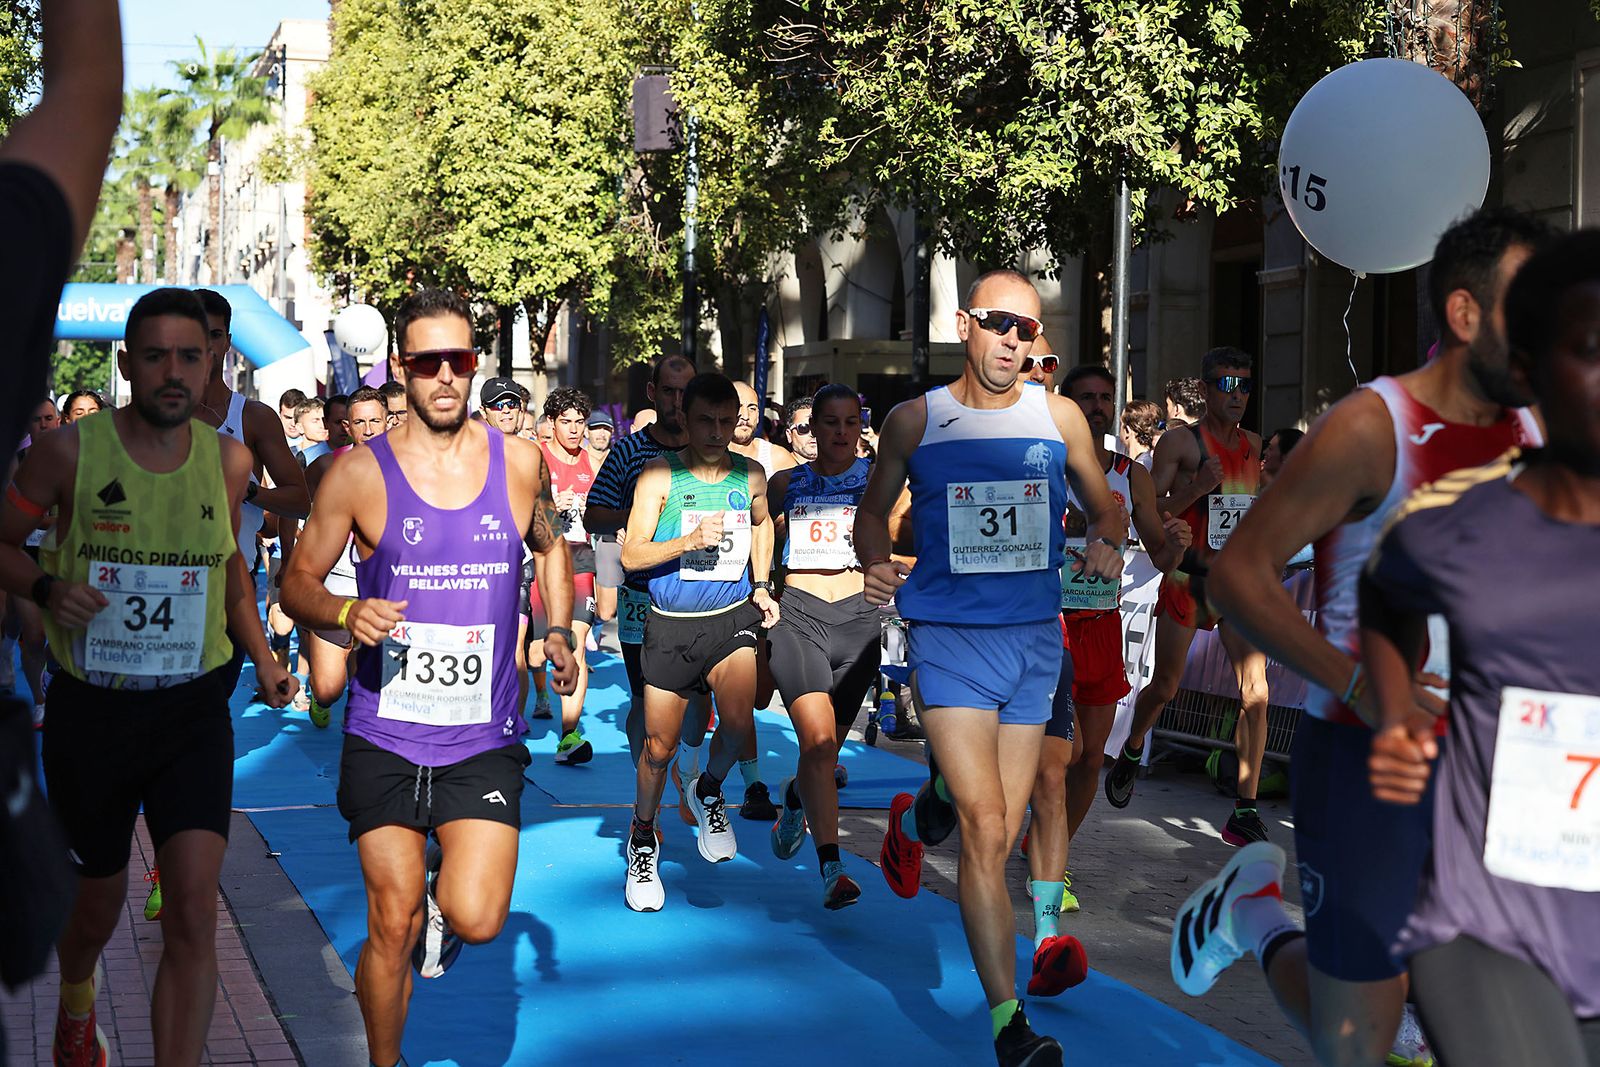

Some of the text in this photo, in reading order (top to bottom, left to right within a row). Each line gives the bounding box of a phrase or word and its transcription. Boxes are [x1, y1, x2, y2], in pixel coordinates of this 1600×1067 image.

[58, 297, 126, 322] uelva
[815, 494, 854, 504] ONUBENSE
[92, 521, 131, 533] valora
[979, 506, 1018, 537] 31
[473, 532, 509, 542] HYROX
[810, 520, 838, 543] 63
[77, 543, 145, 566] AMIGOS
[952, 542, 1042, 554] GUTIERREZ GONZALEZ
[955, 553, 999, 565] Huelva
[460, 562, 510, 575] CENTER
[408, 578, 490, 590] BELLAVISTA
[124, 595, 174, 632] 34
[89, 637, 197, 651] ZAMBRANO CUADRADO
[91, 648, 145, 664] Huelva
[393, 648, 483, 687] 1339
